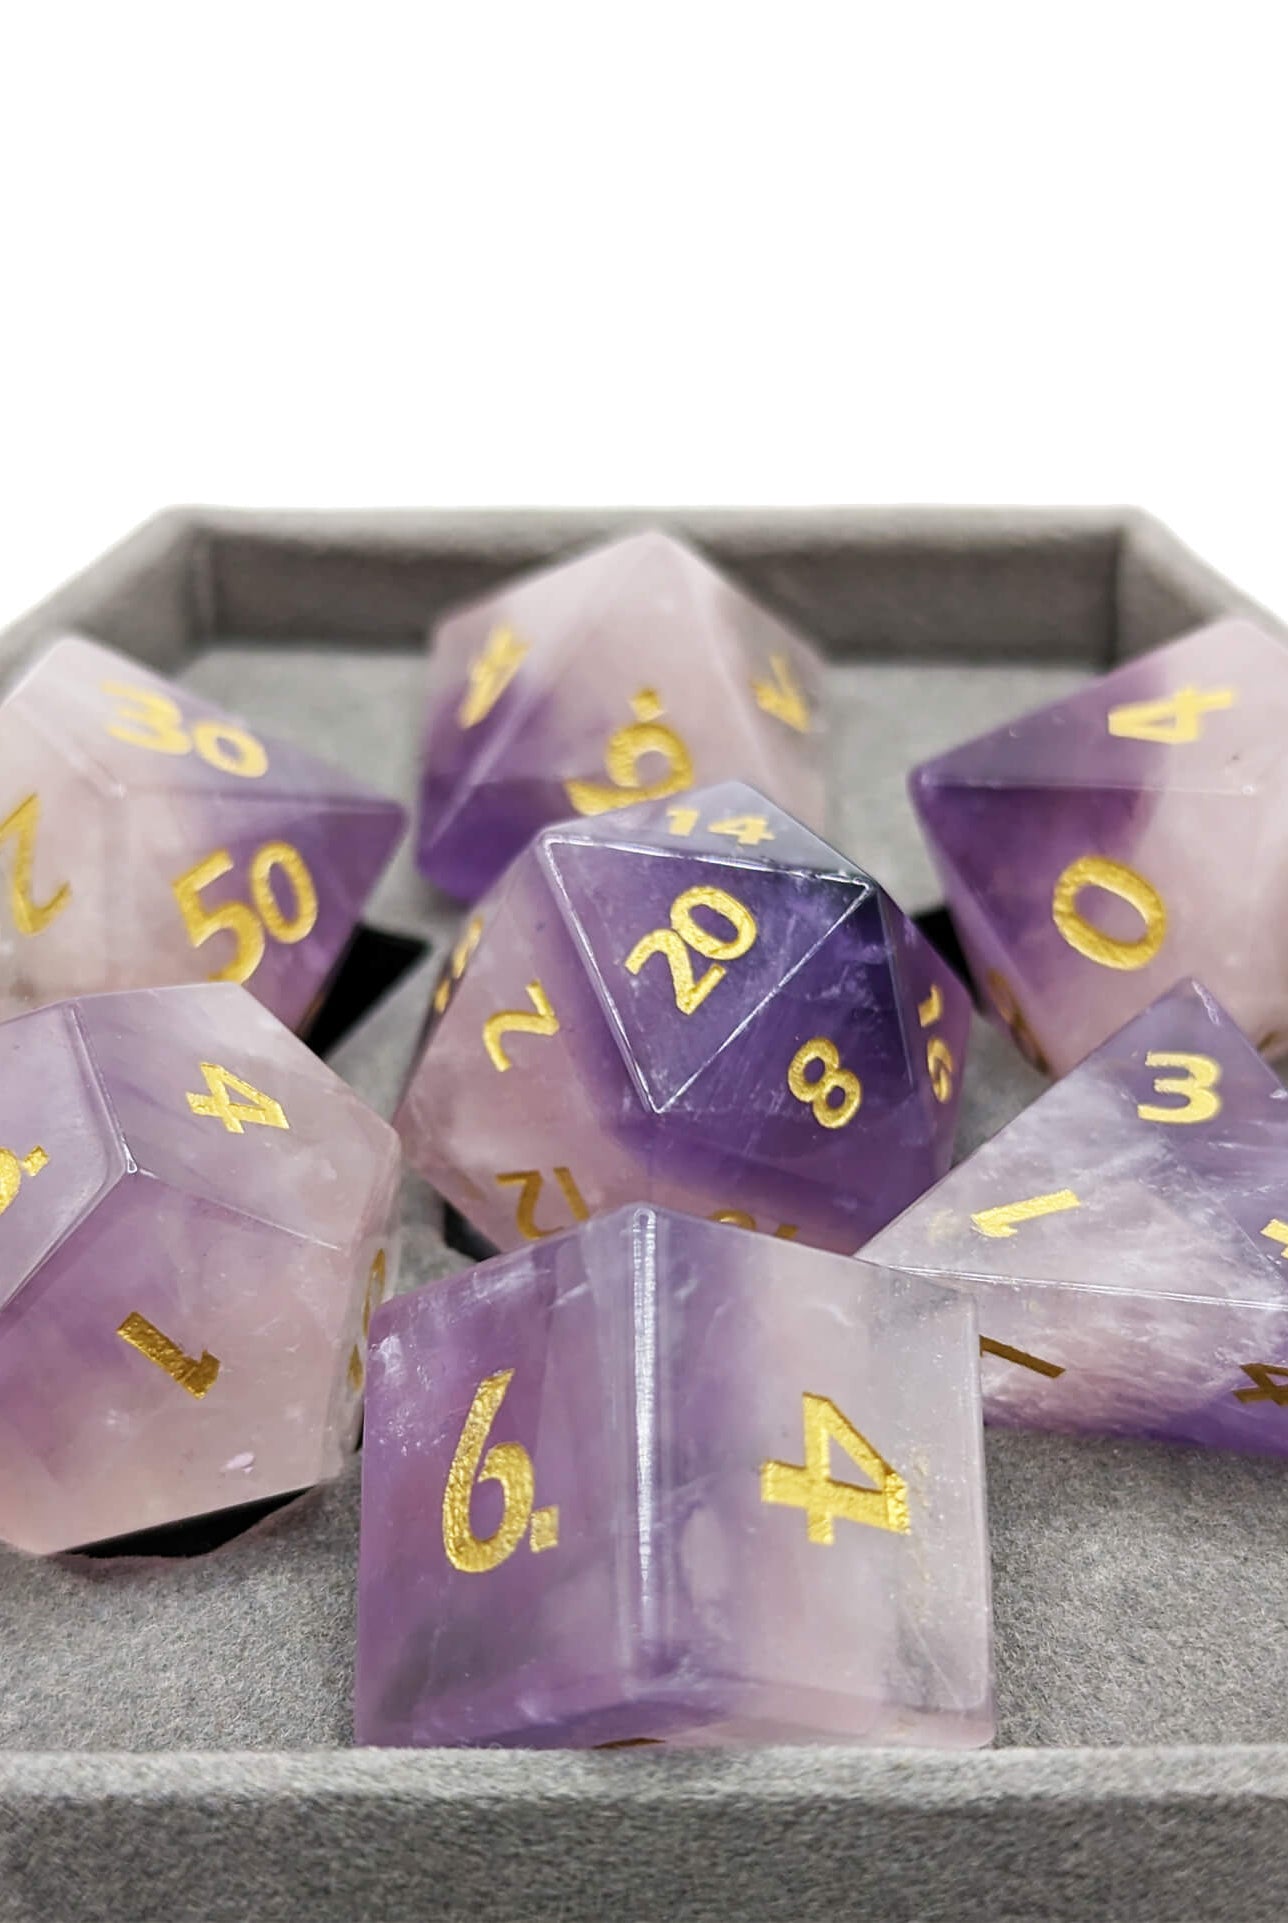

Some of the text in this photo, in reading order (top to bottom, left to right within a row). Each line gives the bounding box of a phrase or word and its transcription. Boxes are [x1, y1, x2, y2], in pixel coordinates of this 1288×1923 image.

[100, 681, 269, 778] 30
[1107, 687, 1238, 745] 4
[664, 806, 776, 846] 14
[171, 841, 318, 986] 50
[625, 885, 758, 1015] 20
[1052, 855, 1167, 971] 0
[482, 980, 560, 1073] 2
[186, 1062, 290, 1134] 4
[788, 1036, 863, 1130] 8
[1137, 1052, 1222, 1123] 3
[971, 1189, 1081, 1238] 1
[116, 1311, 221, 1400] 1
[761, 1391, 912, 1546] 4
